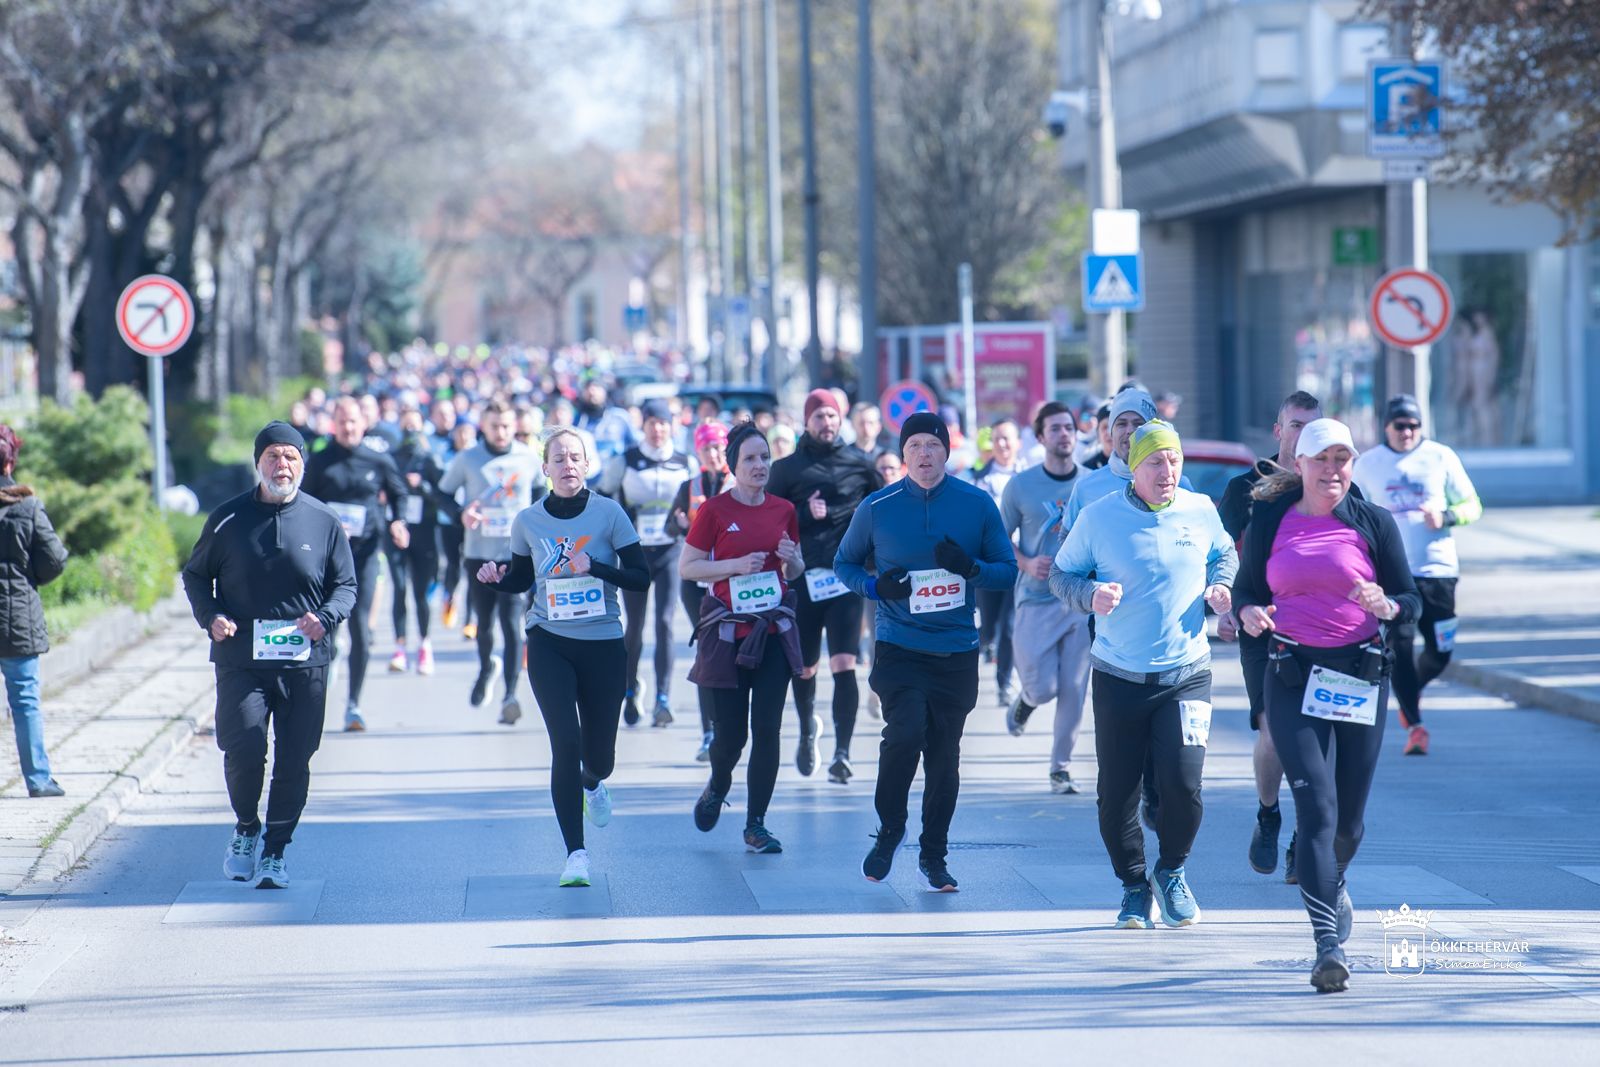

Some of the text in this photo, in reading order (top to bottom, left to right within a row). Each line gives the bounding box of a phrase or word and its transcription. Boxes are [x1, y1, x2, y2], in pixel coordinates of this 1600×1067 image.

[548, 589, 602, 607] 1550
[738, 587, 776, 600] 004
[916, 583, 960, 598] 405
[260, 635, 304, 645] 109
[1314, 688, 1368, 707] 657
